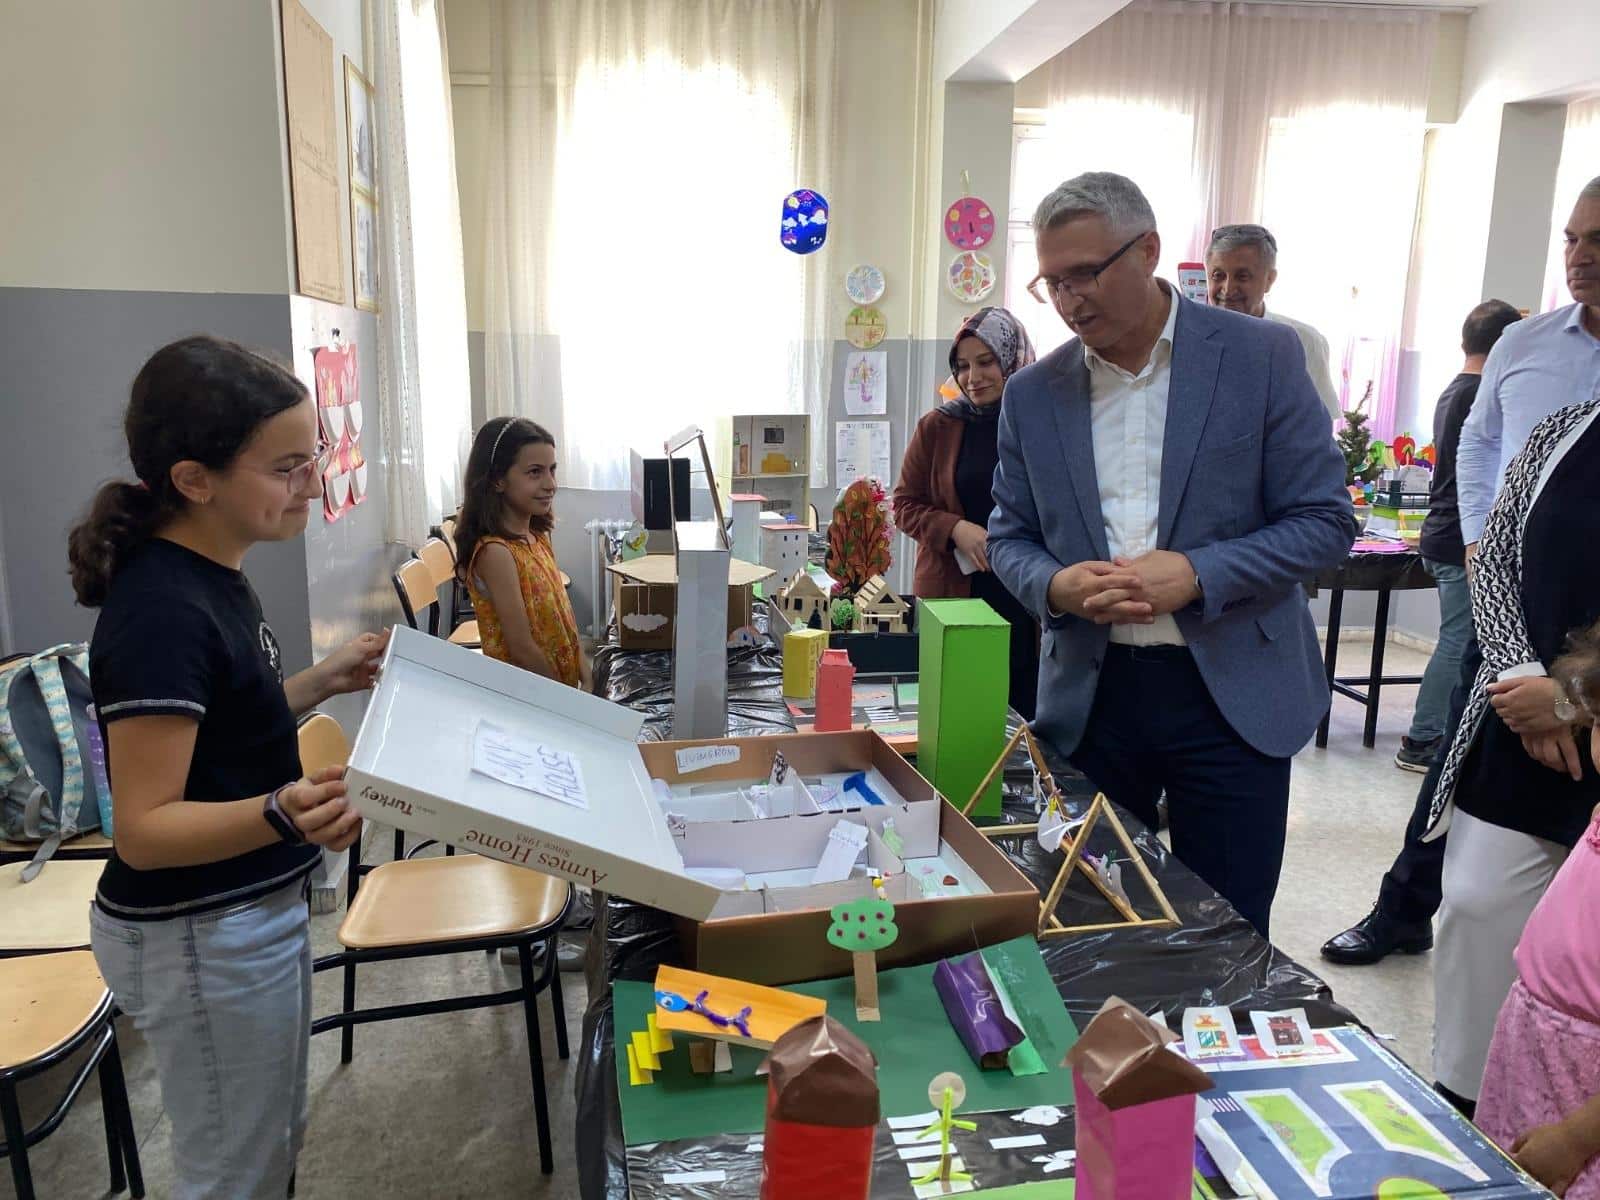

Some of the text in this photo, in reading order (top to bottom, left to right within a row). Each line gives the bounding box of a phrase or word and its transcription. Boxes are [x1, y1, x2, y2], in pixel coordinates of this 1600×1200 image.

[359, 785, 414, 816] Turkey
[465, 828, 608, 887] Armes Home
[515, 832, 573, 857] Since 1985
